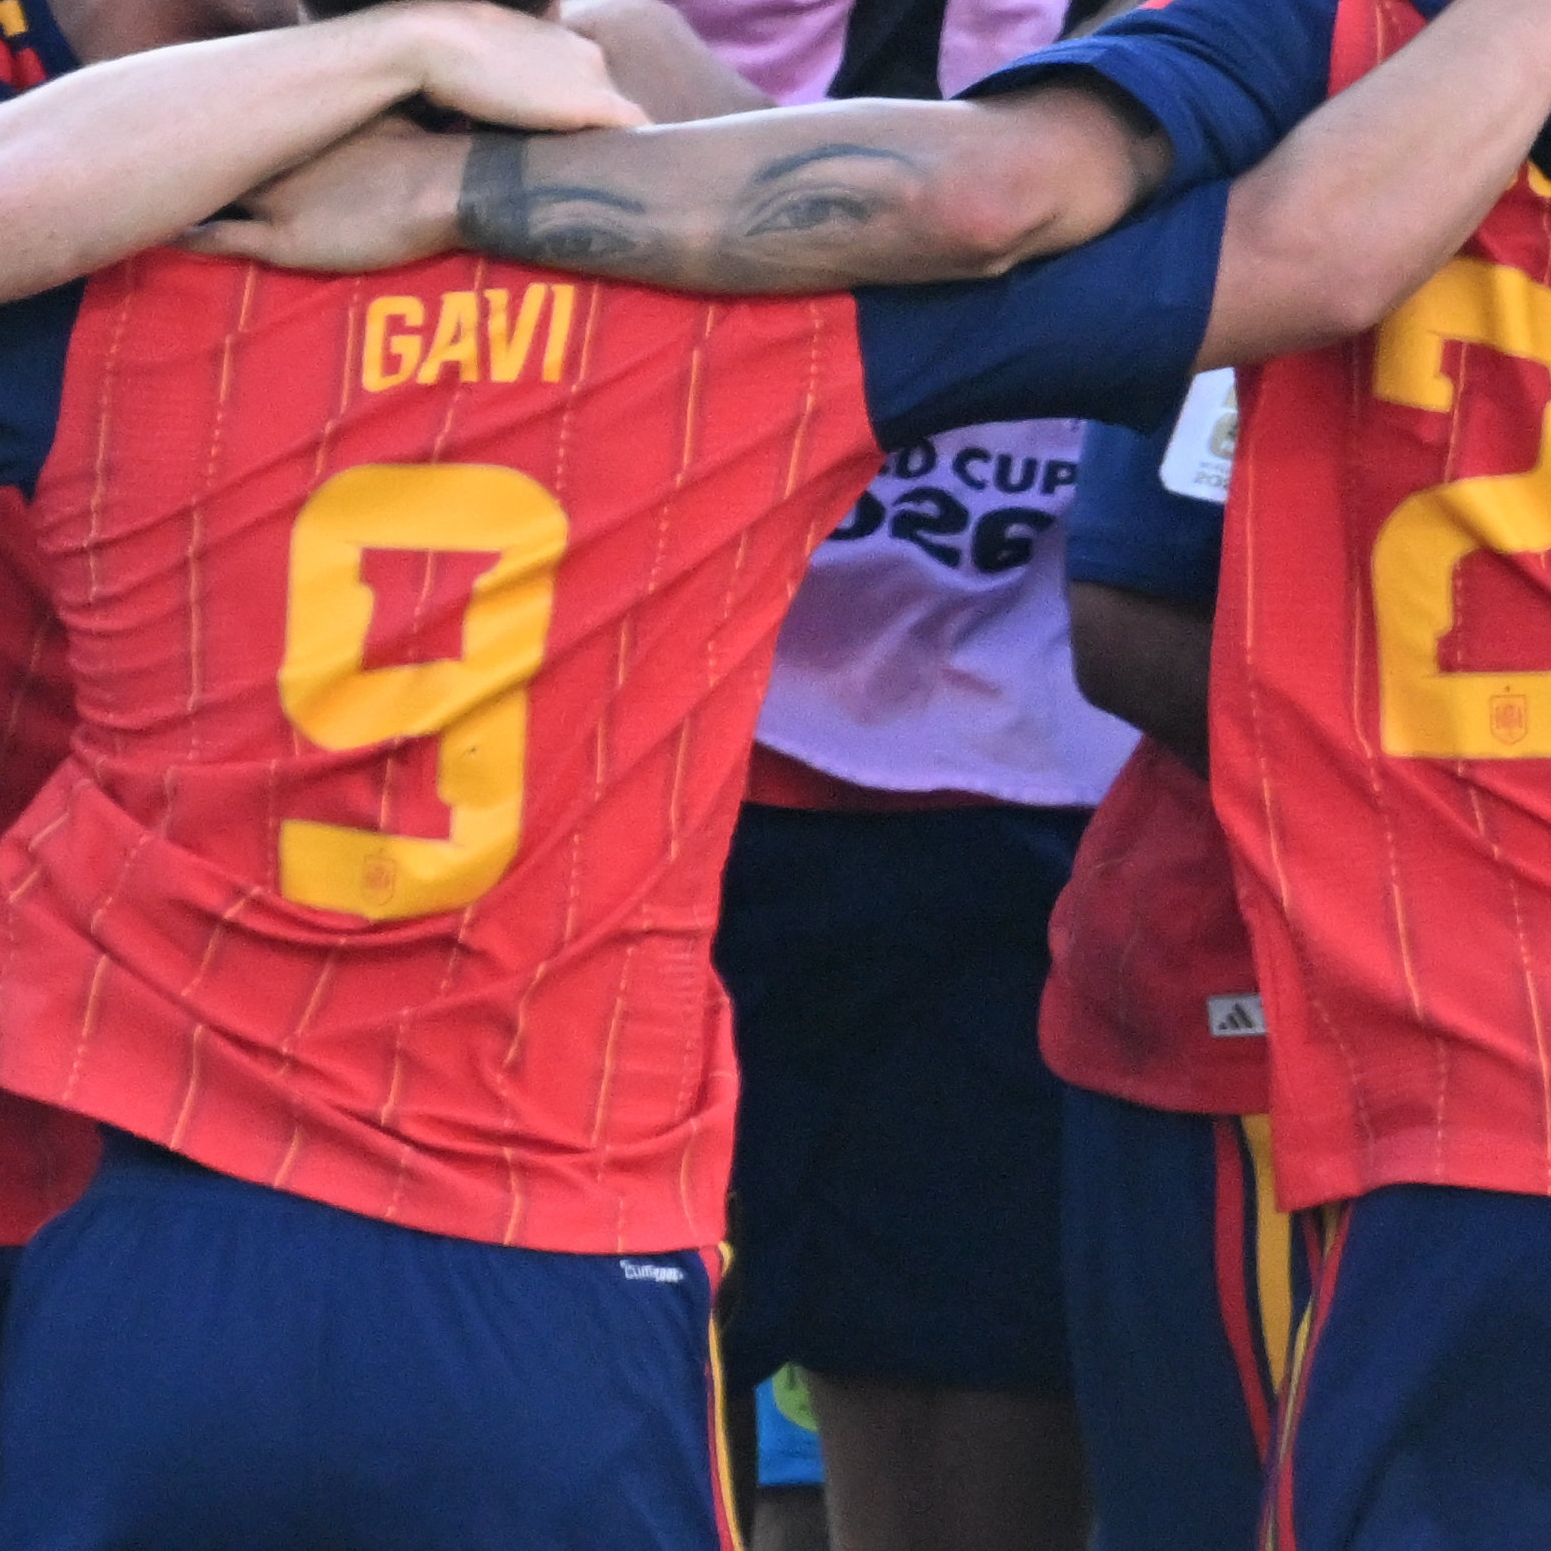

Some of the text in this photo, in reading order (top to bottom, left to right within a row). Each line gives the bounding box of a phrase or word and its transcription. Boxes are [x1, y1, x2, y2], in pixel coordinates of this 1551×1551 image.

[362, 282, 576, 392] GAVI
[953, 447, 1079, 495] CUP
[278, 462, 570, 922] 9
